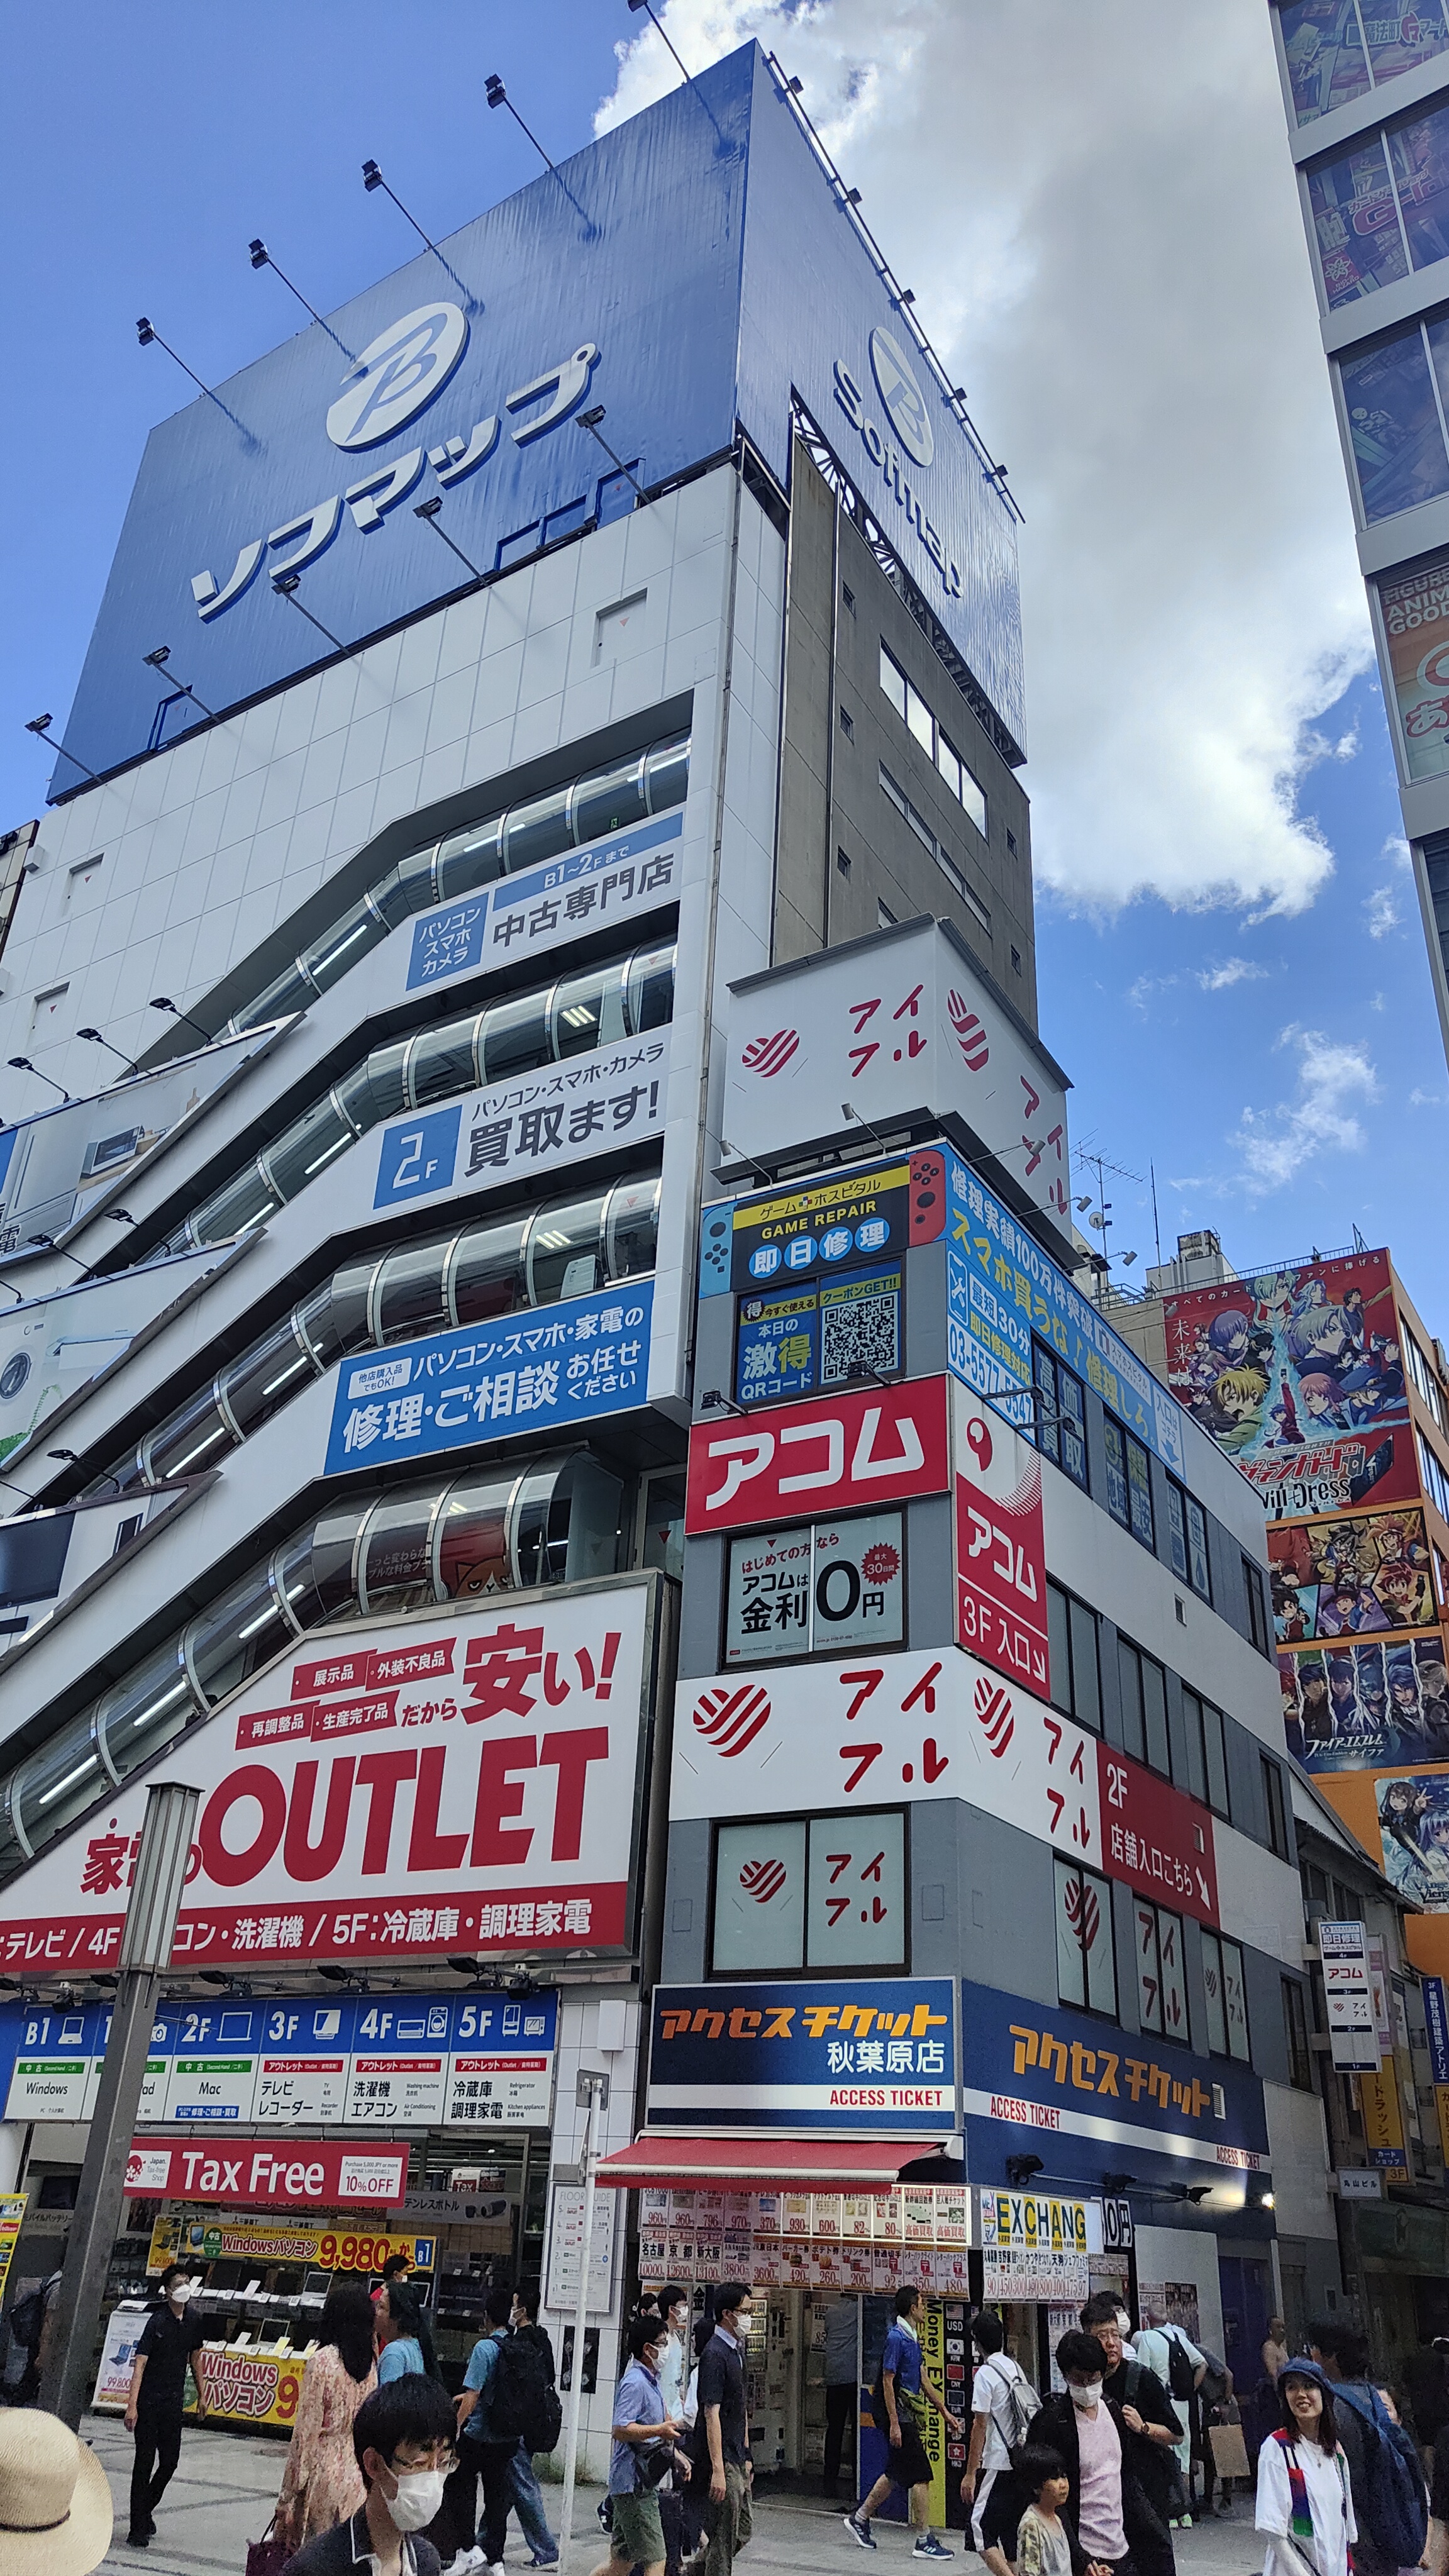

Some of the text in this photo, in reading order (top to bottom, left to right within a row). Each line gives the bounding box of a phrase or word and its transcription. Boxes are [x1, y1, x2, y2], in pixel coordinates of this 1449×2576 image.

[191, 343, 601, 623] ソフマップ
[492, 851, 675, 948] 中古専門店
[419, 906, 482, 944] パソコン
[426, 928, 472, 958] スマホ
[421, 947, 469, 979] カメラ
[471, 1042, 665, 1123] パソコン・スマホ・カメラ
[464, 1080, 660, 1178] 買取ます!
[391, 1130, 439, 1189] 2F
[758, 1177, 881, 1221] ゲーム ホスピタル
[761, 1199, 877, 1240] GAME REPAIR
[752, 1219, 887, 1277] 即日修理
[952, 1159, 1094, 1341] 修理実績100万件突破
[823, 1277, 897, 1304] クーポンGET!!
[747, 1298, 814, 1318] 得 今すぐ使える
[413, 1304, 644, 1381] パソコン・スマホ・家電の
[757, 1318, 799, 1339] 本日の
[566, 1340, 642, 1380] お任せ
[743, 1333, 813, 1380] 激得
[970, 1310, 1031, 1386] 即日修理対応
[357, 1363, 403, 1385] 他店購入品
[363, 1375, 396, 1394] でもOK!
[567, 1370, 636, 1401] ください
[741, 1371, 813, 1401] QRコード
[343, 1360, 560, 1455] 修理・ご相談
[706, 1407, 924, 1511] アコム
[741, 1533, 840, 1574] はじめての方なら
[866, 1562, 896, 1575] 30日間
[874, 1552, 887, 1562] 最大
[968, 1506, 1038, 1602] アコム
[742, 1570, 809, 1597] アコムは
[313, 1663, 354, 1687] 展示品
[377, 1649, 446, 1680] 外装不良品
[460, 1622, 623, 1726] 安い!
[839, 1662, 943, 1721] アイ
[250, 1712, 305, 1739] 再調整品
[322, 1702, 389, 1731] 生産完了品
[401, 1698, 458, 1728] だから
[839, 1738, 950, 1793] フル
[1106, 1762, 1128, 1809] 2F
[199, 1726, 609, 1888] OUTLET
[825, 1851, 886, 1884] アイ
[1110, 1822, 1194, 1898] 店舗入口こちら
[331, 1897, 592, 1946] 5F:冷蔵庫・調理家電
[825, 1896, 888, 1927] フル
[1323, 1933, 1362, 1944] 即日修理
[1328, 1967, 1363, 1980] アコム
[1428, 1982, 1436, 1990] 3F
[25, 2006, 493, 2045] B1 2F 3F 4F 5F
[268, 2061, 304, 2071] アウトレット
[360, 2060, 398, 2070] アウトレット
[460, 2059, 501, 2070] アウトレット
[826, 2038, 945, 2074] 秋葉原店
[26, 2082, 221, 2095] Windows Mac
[261, 2080, 294, 2096] テレビ
[353, 2080, 391, 2097] 洗濯機
[452, 2080, 493, 2098] 冷蔵庫
[829, 2089, 943, 2106] ACCESS TICKET
[258, 2099, 314, 2116] レコーダー
[350, 2101, 398, 2118] エアコン
[450, 2101, 504, 2119] 調理家電
[991, 2096, 1061, 2130] ACCESS TICKET
[1216, 2145, 1260, 2170] ACCESS TICKET
[152, 2174, 164, 2182] Shop
[182, 2151, 325, 2196] Tax Free
[1343, 2180, 1377, 2189] 丸山ビル
[1390, 2169, 1405, 2179] 3F
[560, 2191, 586, 2202] FLOOR
[906, 2224, 934, 2237] 高価買取
[936, 2224, 965, 2238] 高価買取
[996, 2196, 1087, 2240] EXCHANG
[221, 2233, 318, 2258] Windowsパソコン
[319, 2235, 391, 2272] 9,980
[418, 2243, 430, 2263] B1
[642, 2242, 665, 2257] 名古屋
[697, 2245, 721, 2260] 新大阪
[874, 2250, 902, 2258] 普通切手
[926, 2299, 942, 2359] Money
[947, 2320, 963, 2332] USD
[201, 2351, 279, 2386] Windows
[204, 2381, 275, 2417] パソコン
